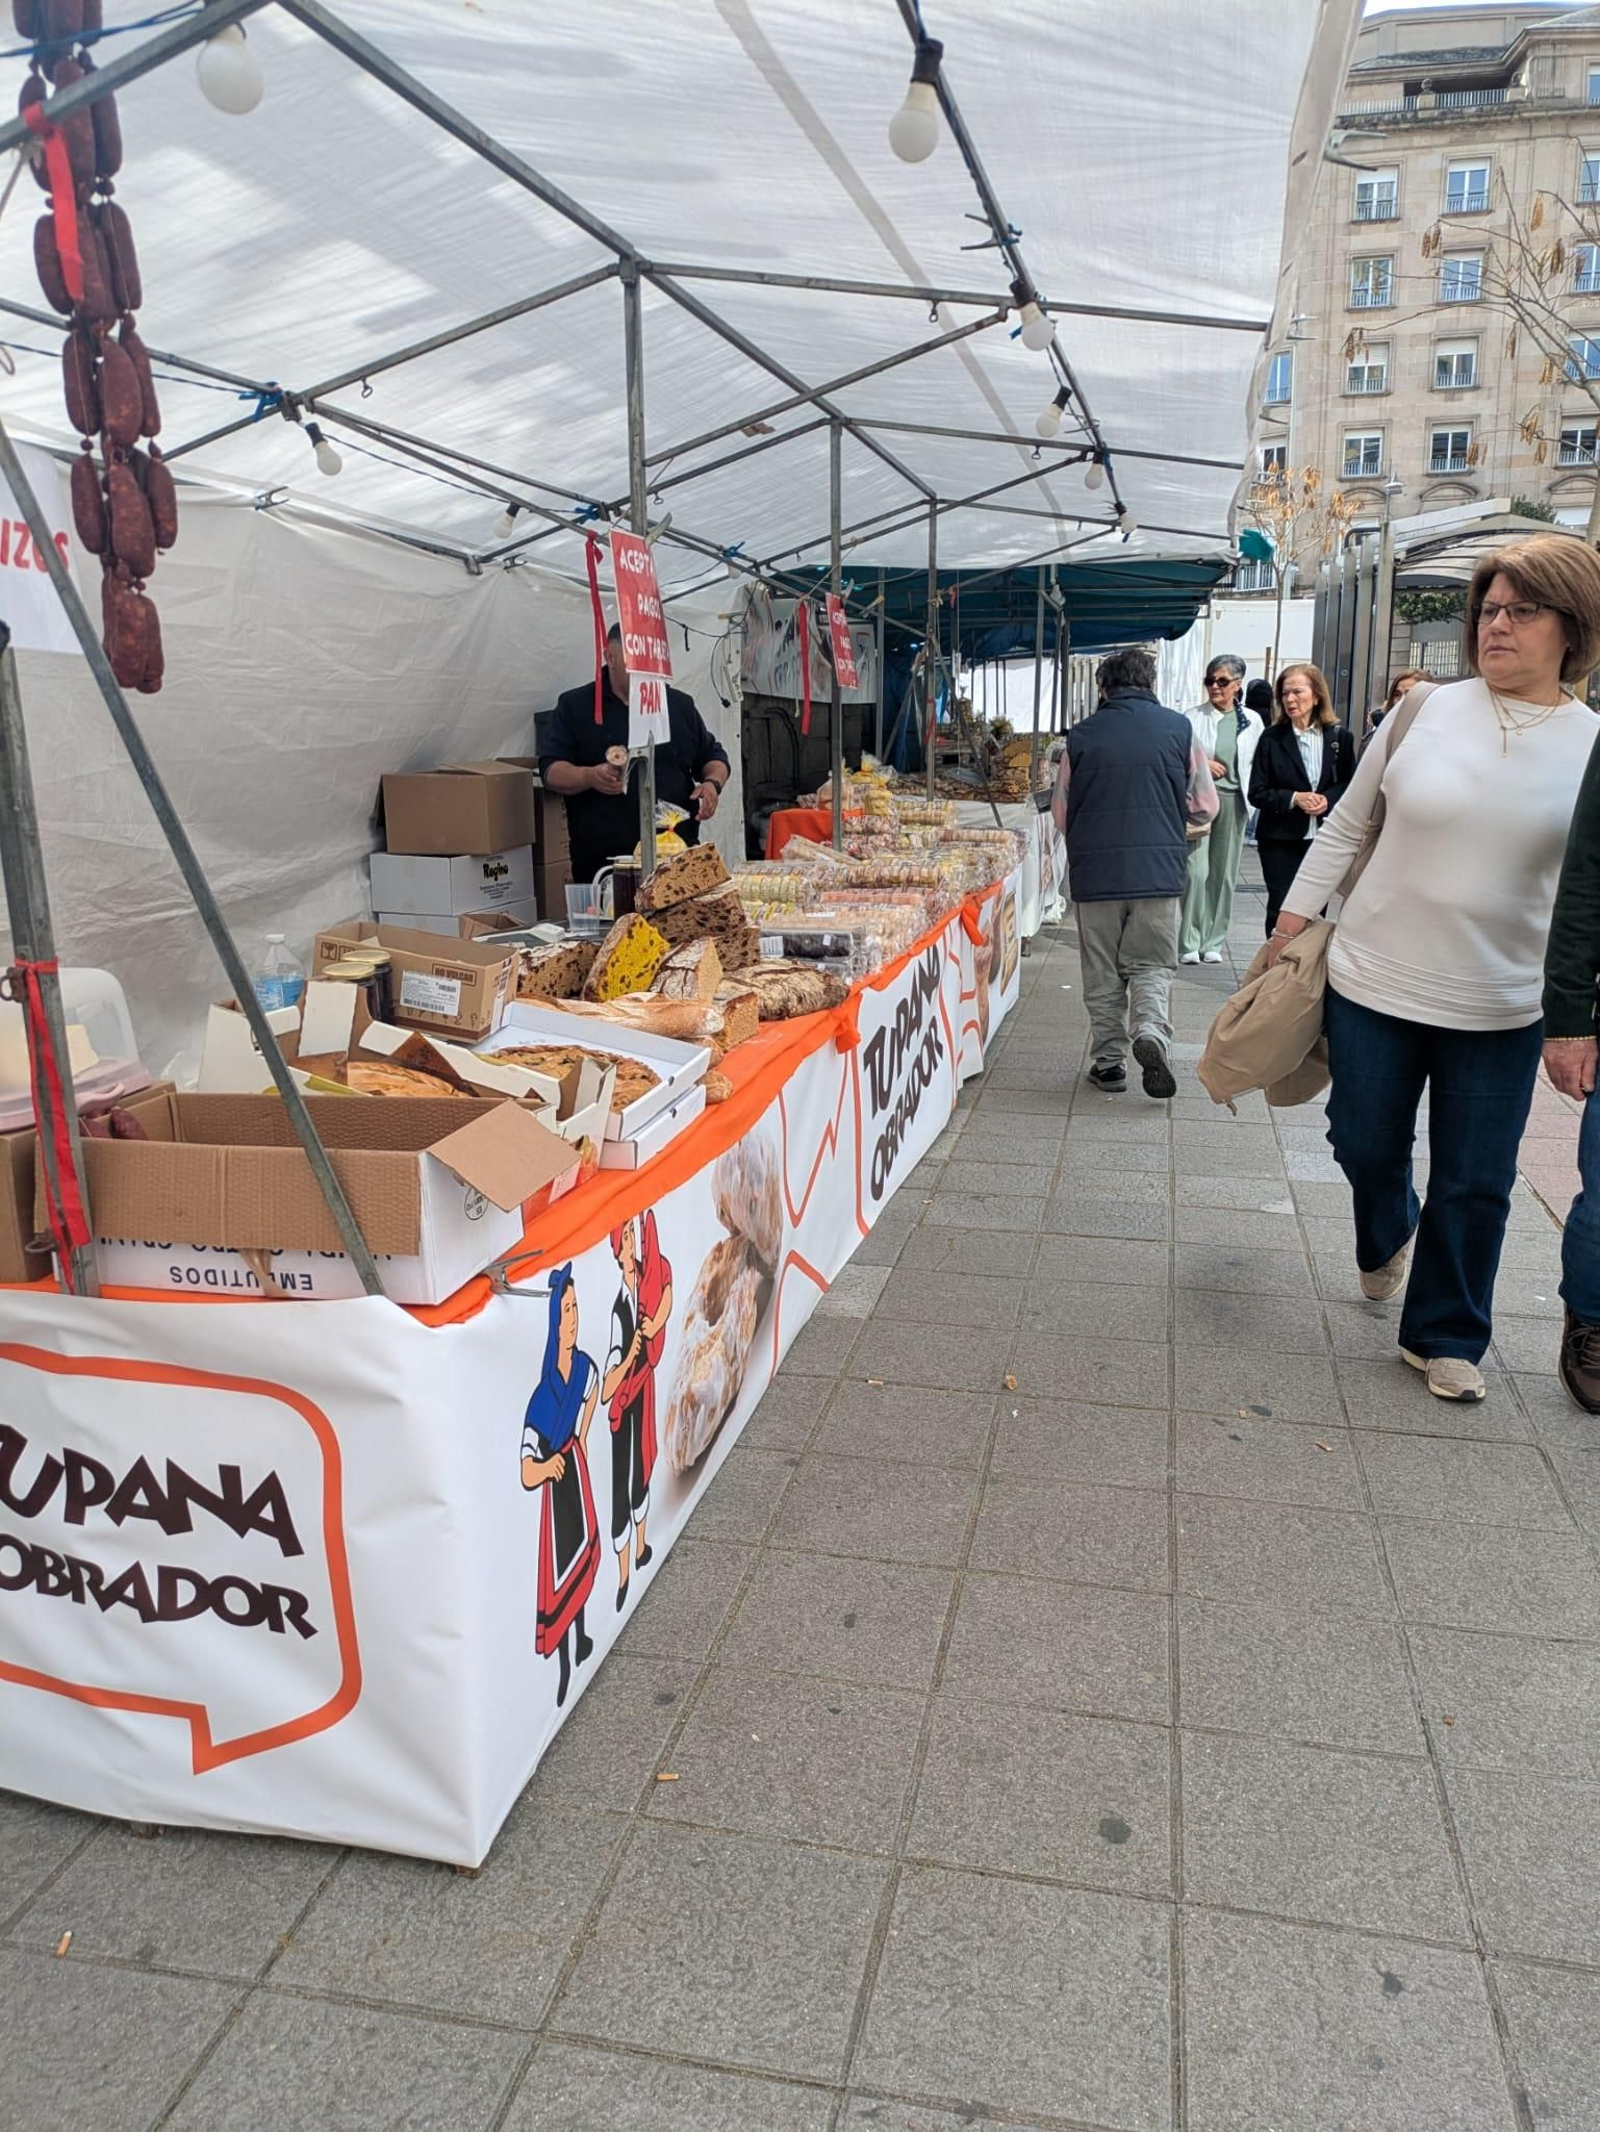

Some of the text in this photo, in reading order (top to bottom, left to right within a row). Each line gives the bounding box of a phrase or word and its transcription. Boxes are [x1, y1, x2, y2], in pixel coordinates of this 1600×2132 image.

[625, 633, 646, 657] CON
[639, 681, 661, 715] PAN
[863, 944, 941, 1120] TUPANA
[870, 1015, 943, 1201] OBRADOR
[0, 1423, 305, 1558] UPANA
[0, 1532, 319, 1640] OBRADOR
